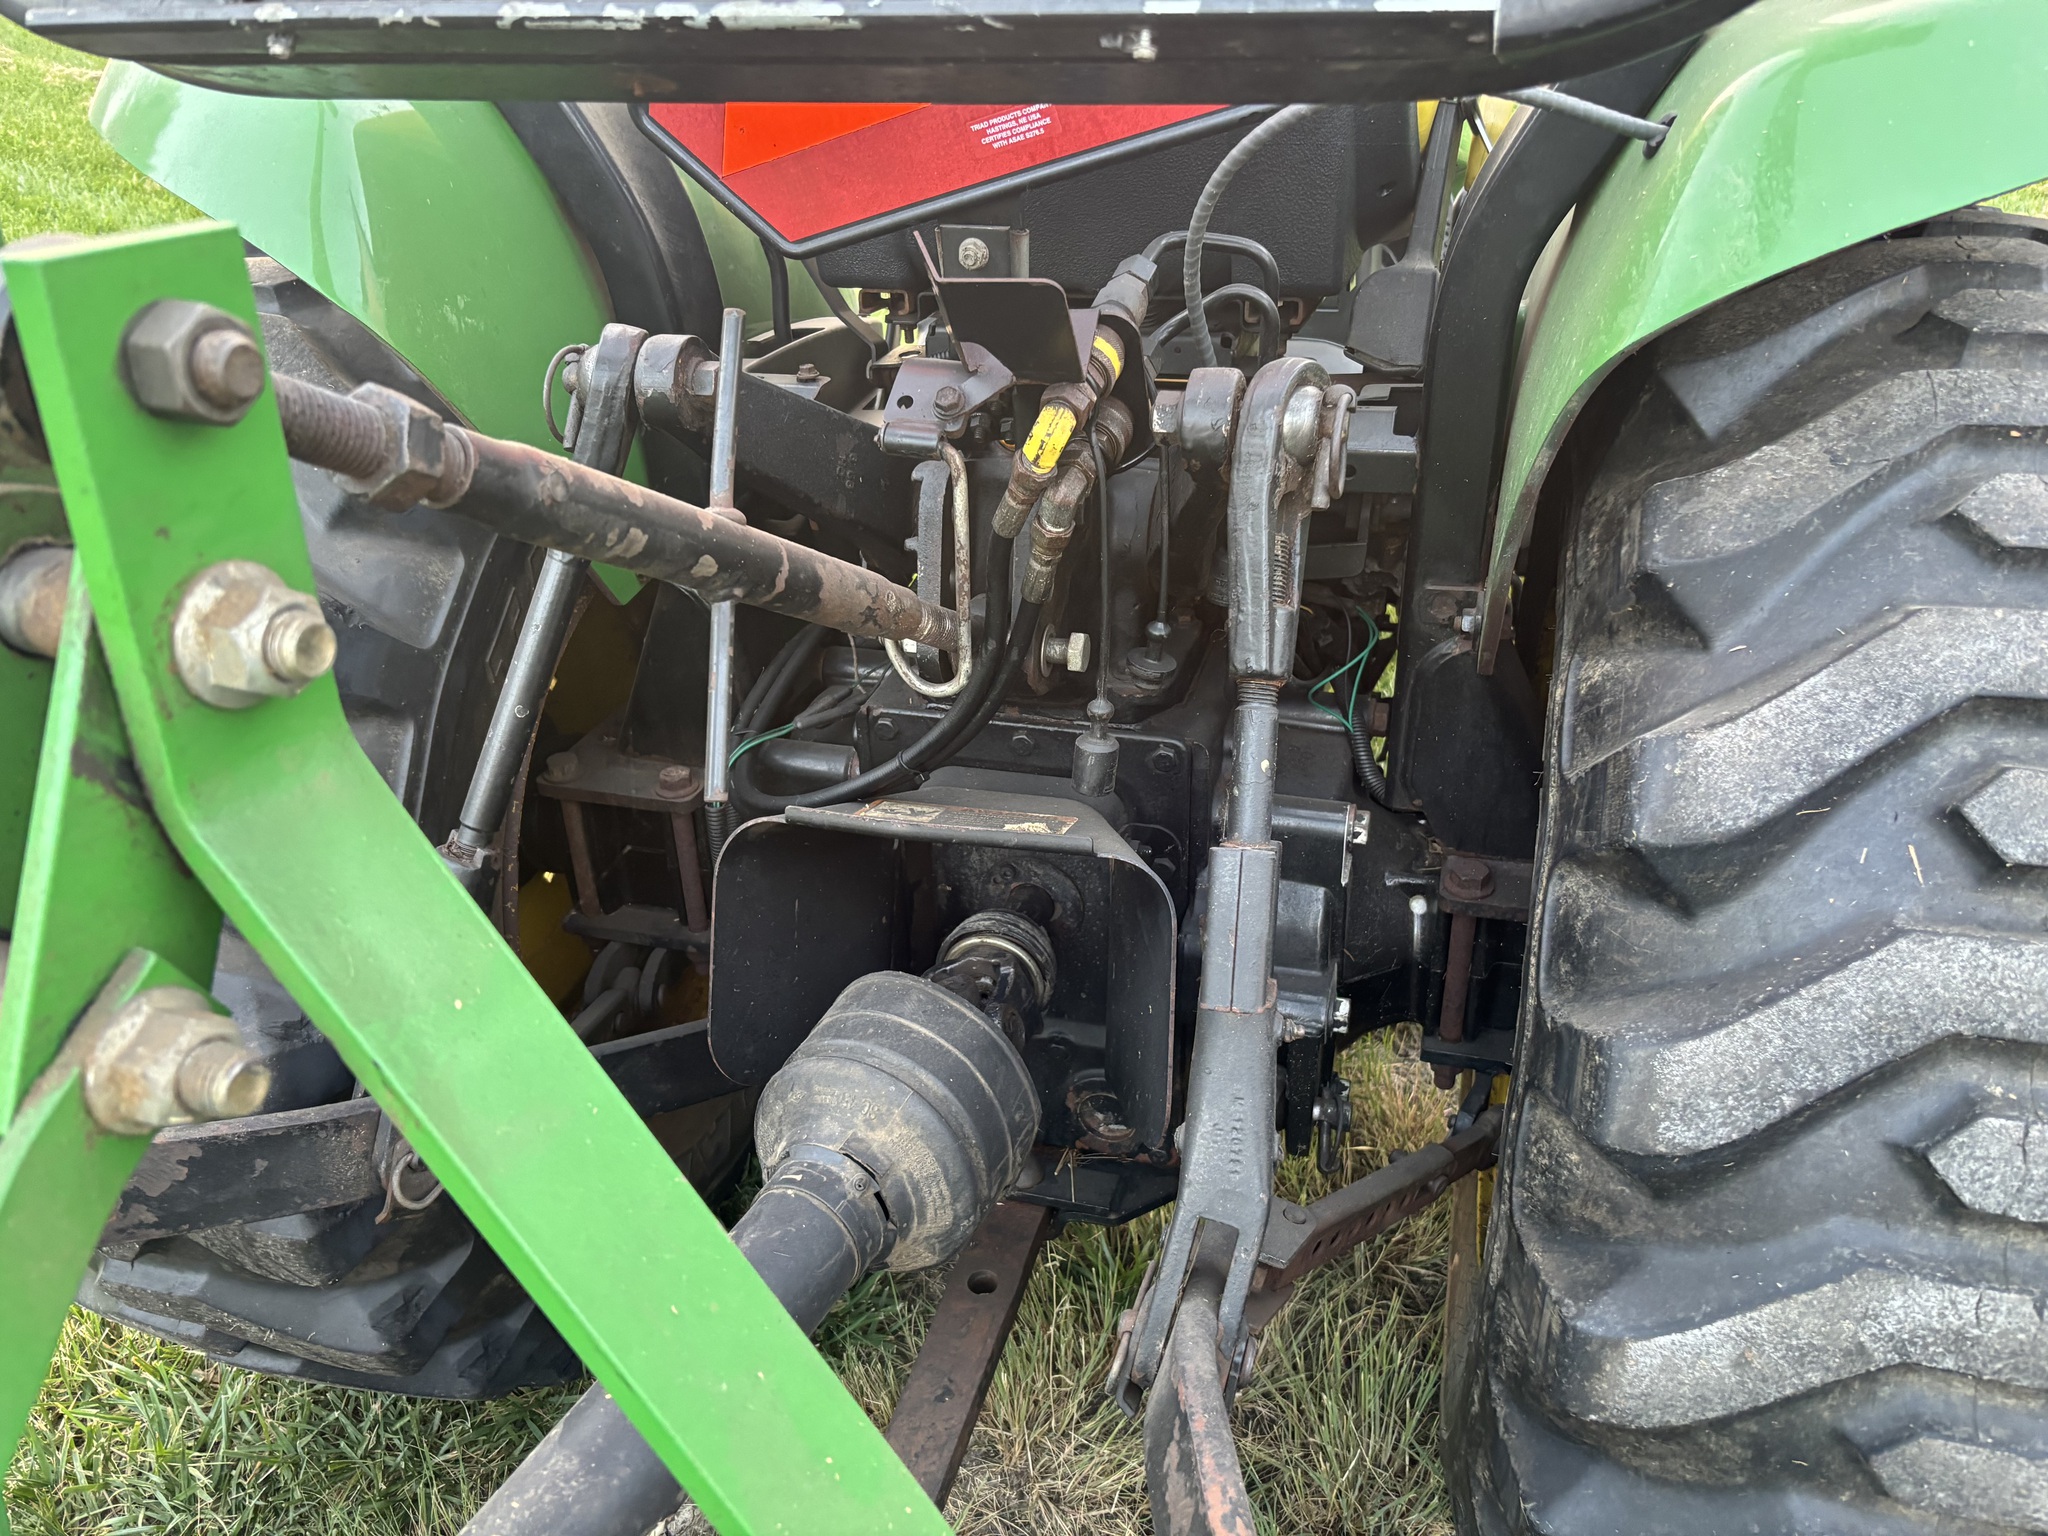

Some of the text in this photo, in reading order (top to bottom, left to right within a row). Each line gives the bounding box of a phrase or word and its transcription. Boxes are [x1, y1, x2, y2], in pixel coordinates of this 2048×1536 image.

[970, 121, 989, 132] TRIAD
[989, 110, 1022, 126] PRODUCTS
[981, 116, 1052, 145] CERTIFIES COMPLIANCE
[986, 112, 1042, 135] HASTINGS, NE USA
[992, 139, 1008, 149] WITH
[1008, 134, 1025, 145] ASAE
